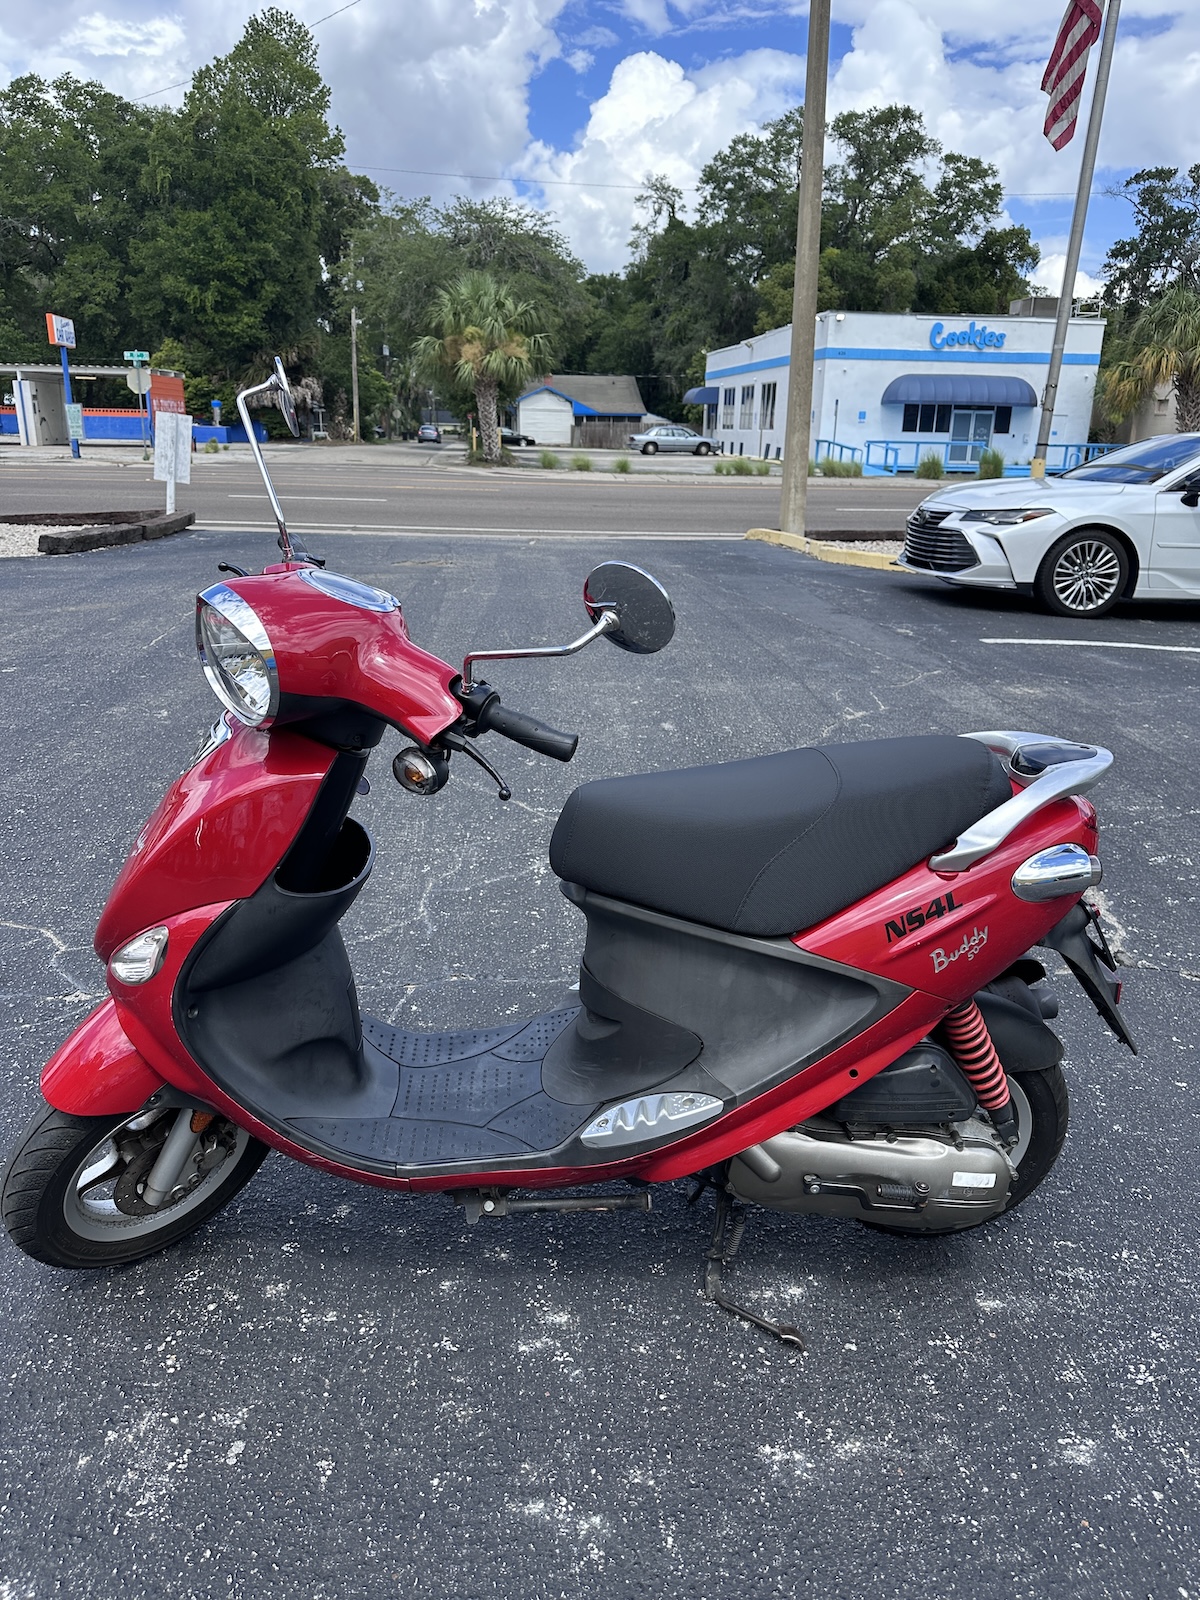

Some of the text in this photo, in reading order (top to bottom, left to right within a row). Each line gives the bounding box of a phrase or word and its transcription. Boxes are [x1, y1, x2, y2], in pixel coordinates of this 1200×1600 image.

[930, 321, 1006, 349] Cookies
[884, 892, 963, 943] NS4L
[929, 926, 988, 973] Buddy
[968, 946, 980, 961] 50
